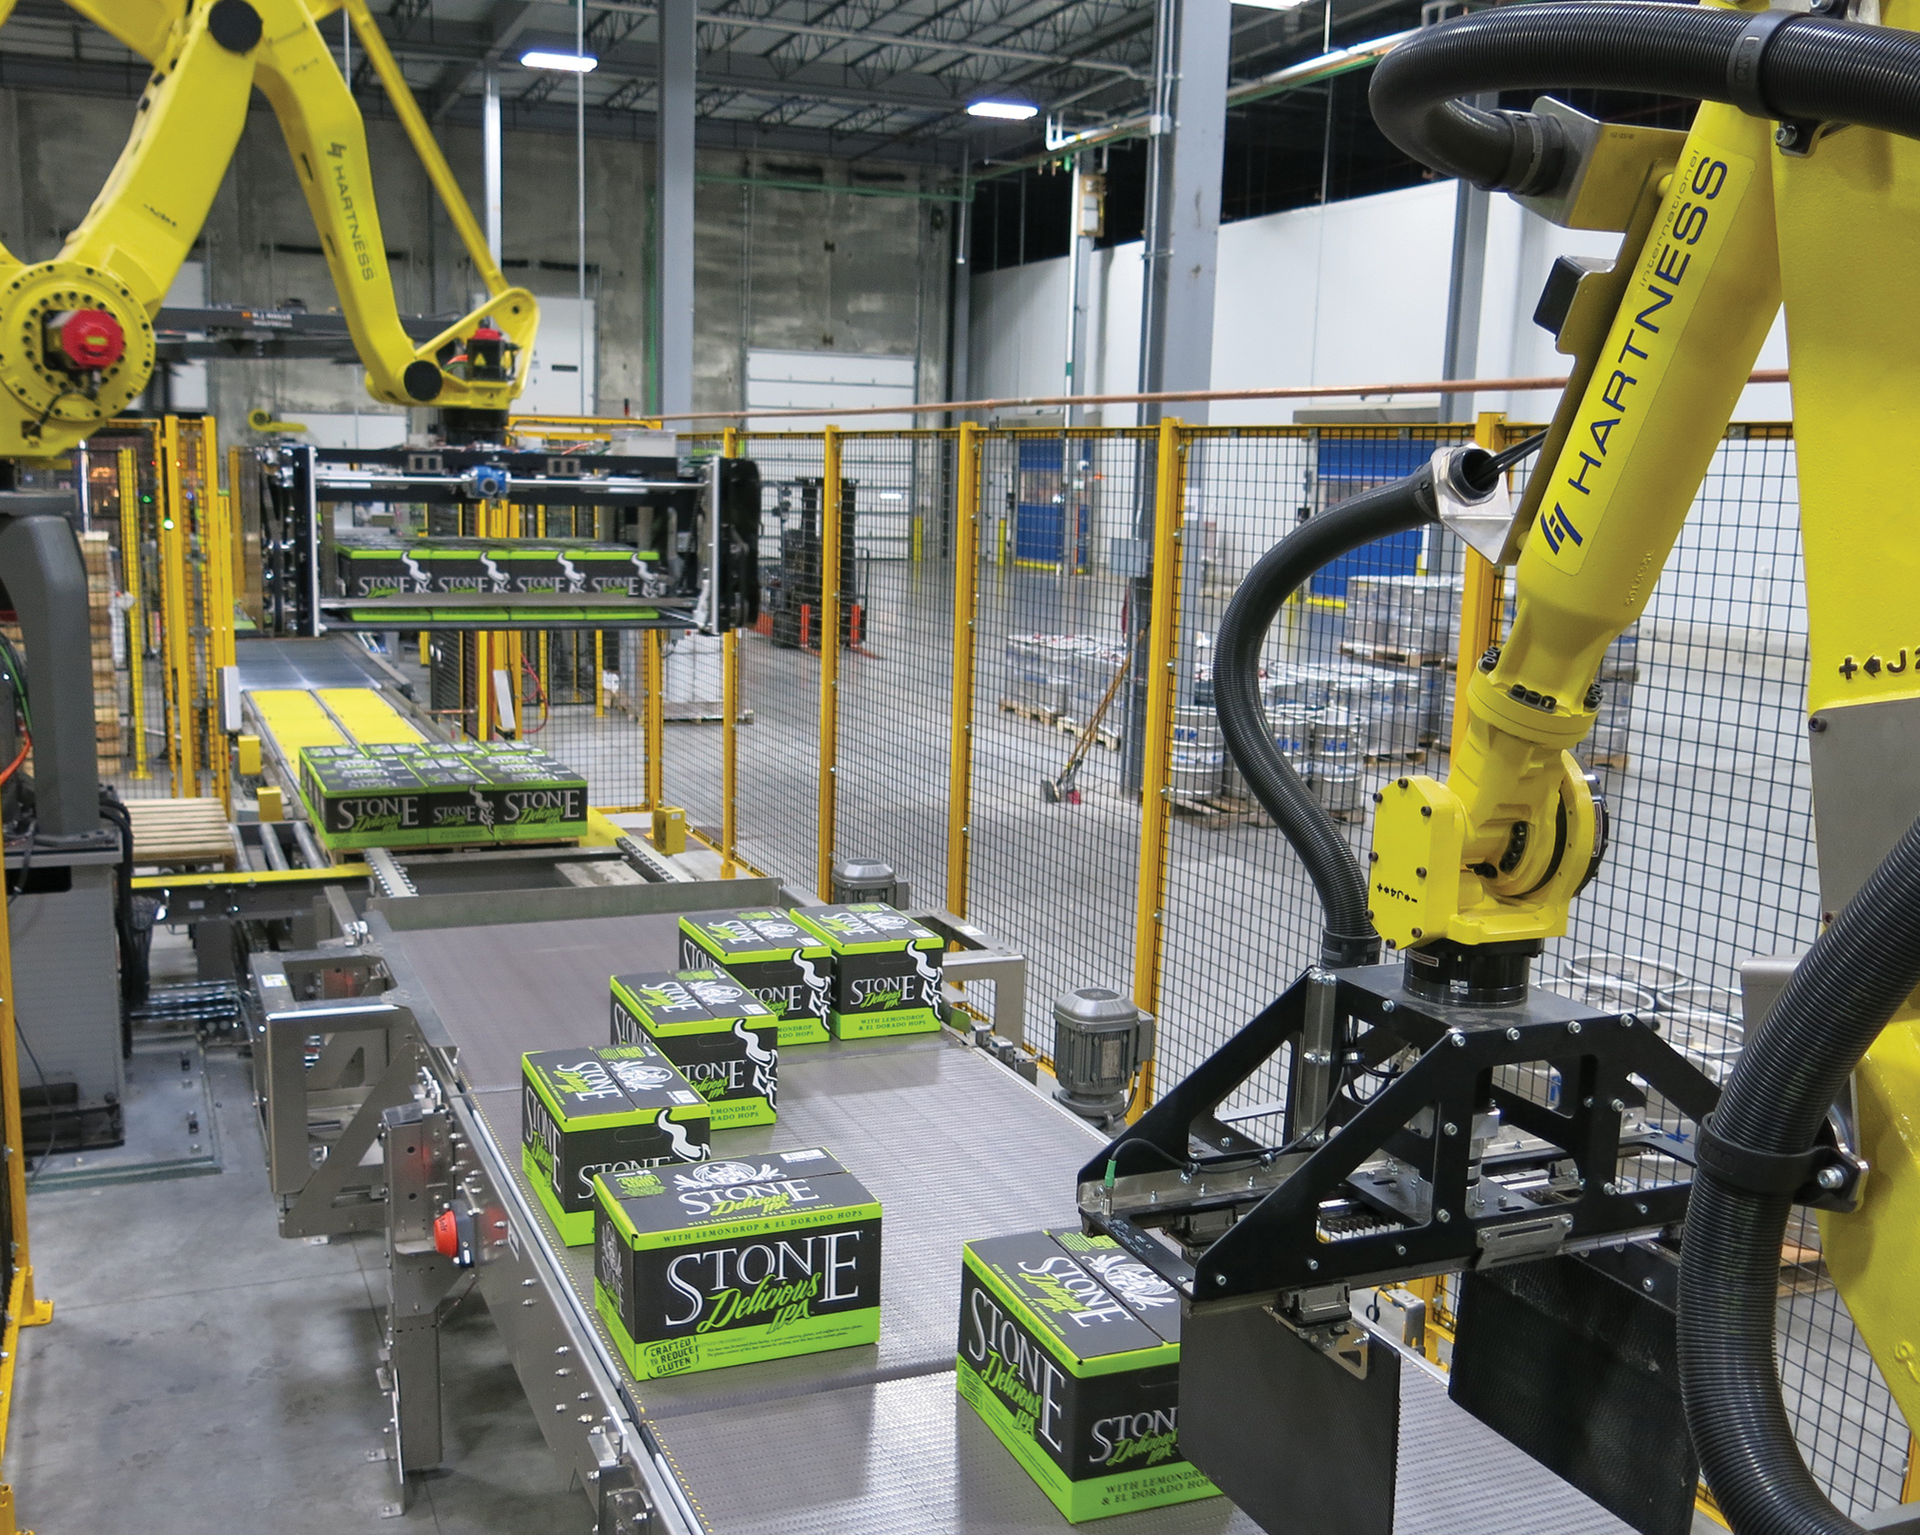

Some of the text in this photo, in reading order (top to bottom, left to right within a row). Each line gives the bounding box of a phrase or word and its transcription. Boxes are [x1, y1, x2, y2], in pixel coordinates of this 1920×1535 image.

[334, 165, 374, 281] HARTNESS
[1639, 149, 1700, 288] international
[1567, 156, 1728, 495] HARTNESS
[337, 796, 419, 829] STONE
[433, 805, 477, 824] STONE
[504, 790, 580, 821] STONE
[850, 974, 917, 1006] STONE
[795, 1030, 814, 1038] HOPS
[876, 1022, 906, 1030] DORADO
[882, 1014, 925, 1023] LEMONDROP
[677, 1059, 745, 1090] TONE
[707, 1087, 727, 1100] IPA
[710, 1104, 758, 1116] EMONDROP
[711, 1110, 759, 1122] RADO HOPS
[678, 1179, 820, 1216] STONE
[709, 1191, 790, 1217] Delicious
[762, 1200, 790, 1214] IPA
[663, 1209, 864, 1243] WITH LEMONDROP & EL DORADO HOPS
[665, 1230, 861, 1326] STONE
[1017, 1256, 1137, 1328] STONE
[696, 1272, 823, 1333] Delicious
[766, 1298, 811, 1335] IPA
[650, 1338, 691, 1357] CRAFTED
[660, 1345, 694, 1363] REDUCE
[656, 1356, 691, 1374] GLUTEN
[968, 1287, 1067, 1453] STONE
[980, 1347, 1043, 1419] Delicious
[1012, 1408, 1037, 1441] IPA
[1089, 1407, 1178, 1463] STON
[1105, 1480, 1139, 1495] WITH
[1114, 1493, 1127, 1503] EL
[1131, 1483, 1185, 1500] DORADO
